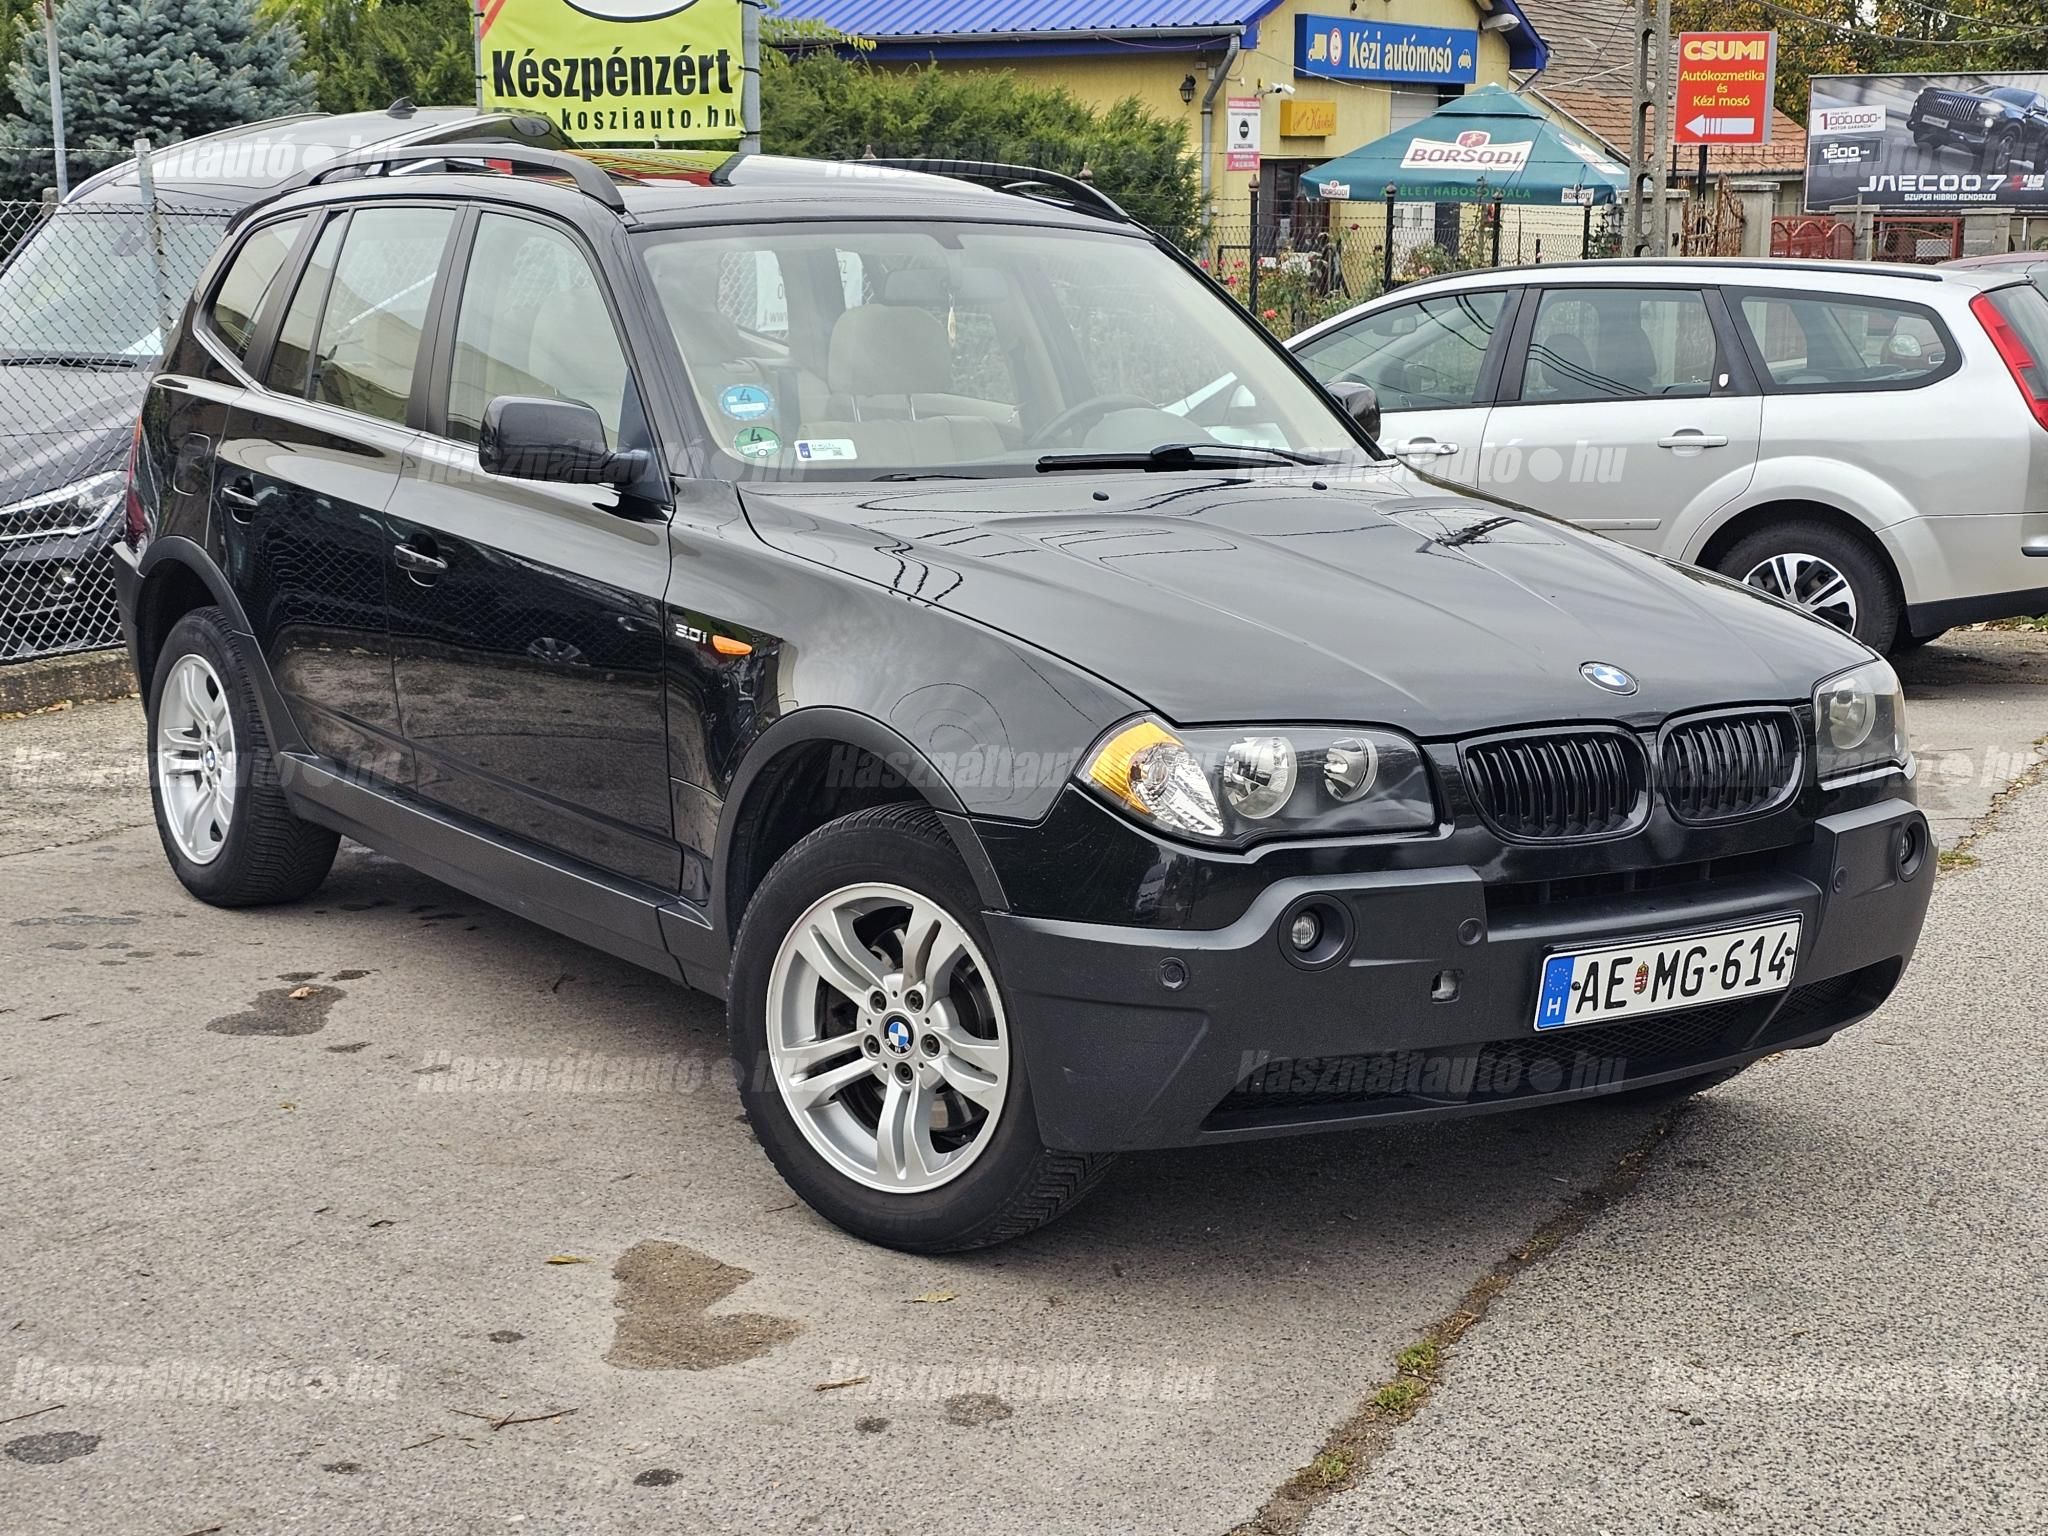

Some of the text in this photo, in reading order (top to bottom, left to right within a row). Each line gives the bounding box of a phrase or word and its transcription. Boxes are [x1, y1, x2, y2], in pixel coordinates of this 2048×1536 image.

[1349, 29, 1453, 74] Kézi autómosó
[1683, 40, 1766, 61] CSUMI
[492, 44, 734, 103] Készpénzért
[1680, 69, 1766, 81] Autókozmetika
[1716, 82, 1729, 94] és
[1692, 94, 1751, 107] Kézi mosó
[1409, 147, 1523, 165] BORSODI
[1821, 146, 1860, 159] 1200
[1400, 183, 1430, 197] ÉLET
[1433, 185, 1477, 198] HABOS
[1857, 174, 1981, 192] JAECOO
[1986, 174, 2008, 192] 7
[1320, 188, 1349, 198] BORSODI
[1904, 193, 1997, 202] SZUPER HIBRID RENDSZER
[750, 428, 763, 443] 4
[1575, 931, 1789, 1014] AE MG-614
[1546, 997, 1561, 1017] H
